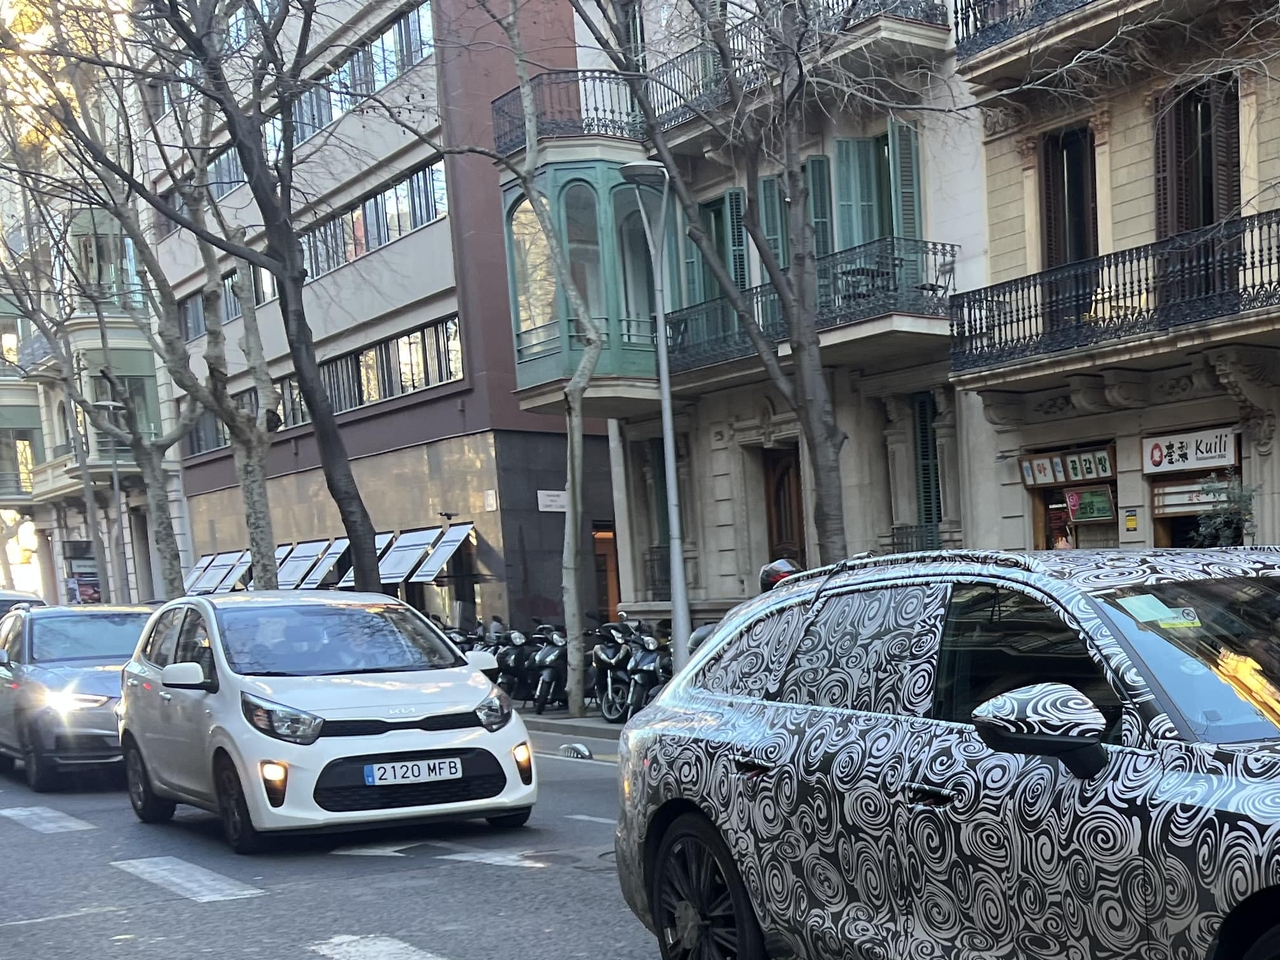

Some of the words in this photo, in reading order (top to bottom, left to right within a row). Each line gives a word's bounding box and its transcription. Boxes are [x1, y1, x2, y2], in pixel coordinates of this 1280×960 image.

[1195, 434, 1228, 456] Kuili
[377, 764, 421, 781] 2120
[427, 761, 458, 777] MFB
